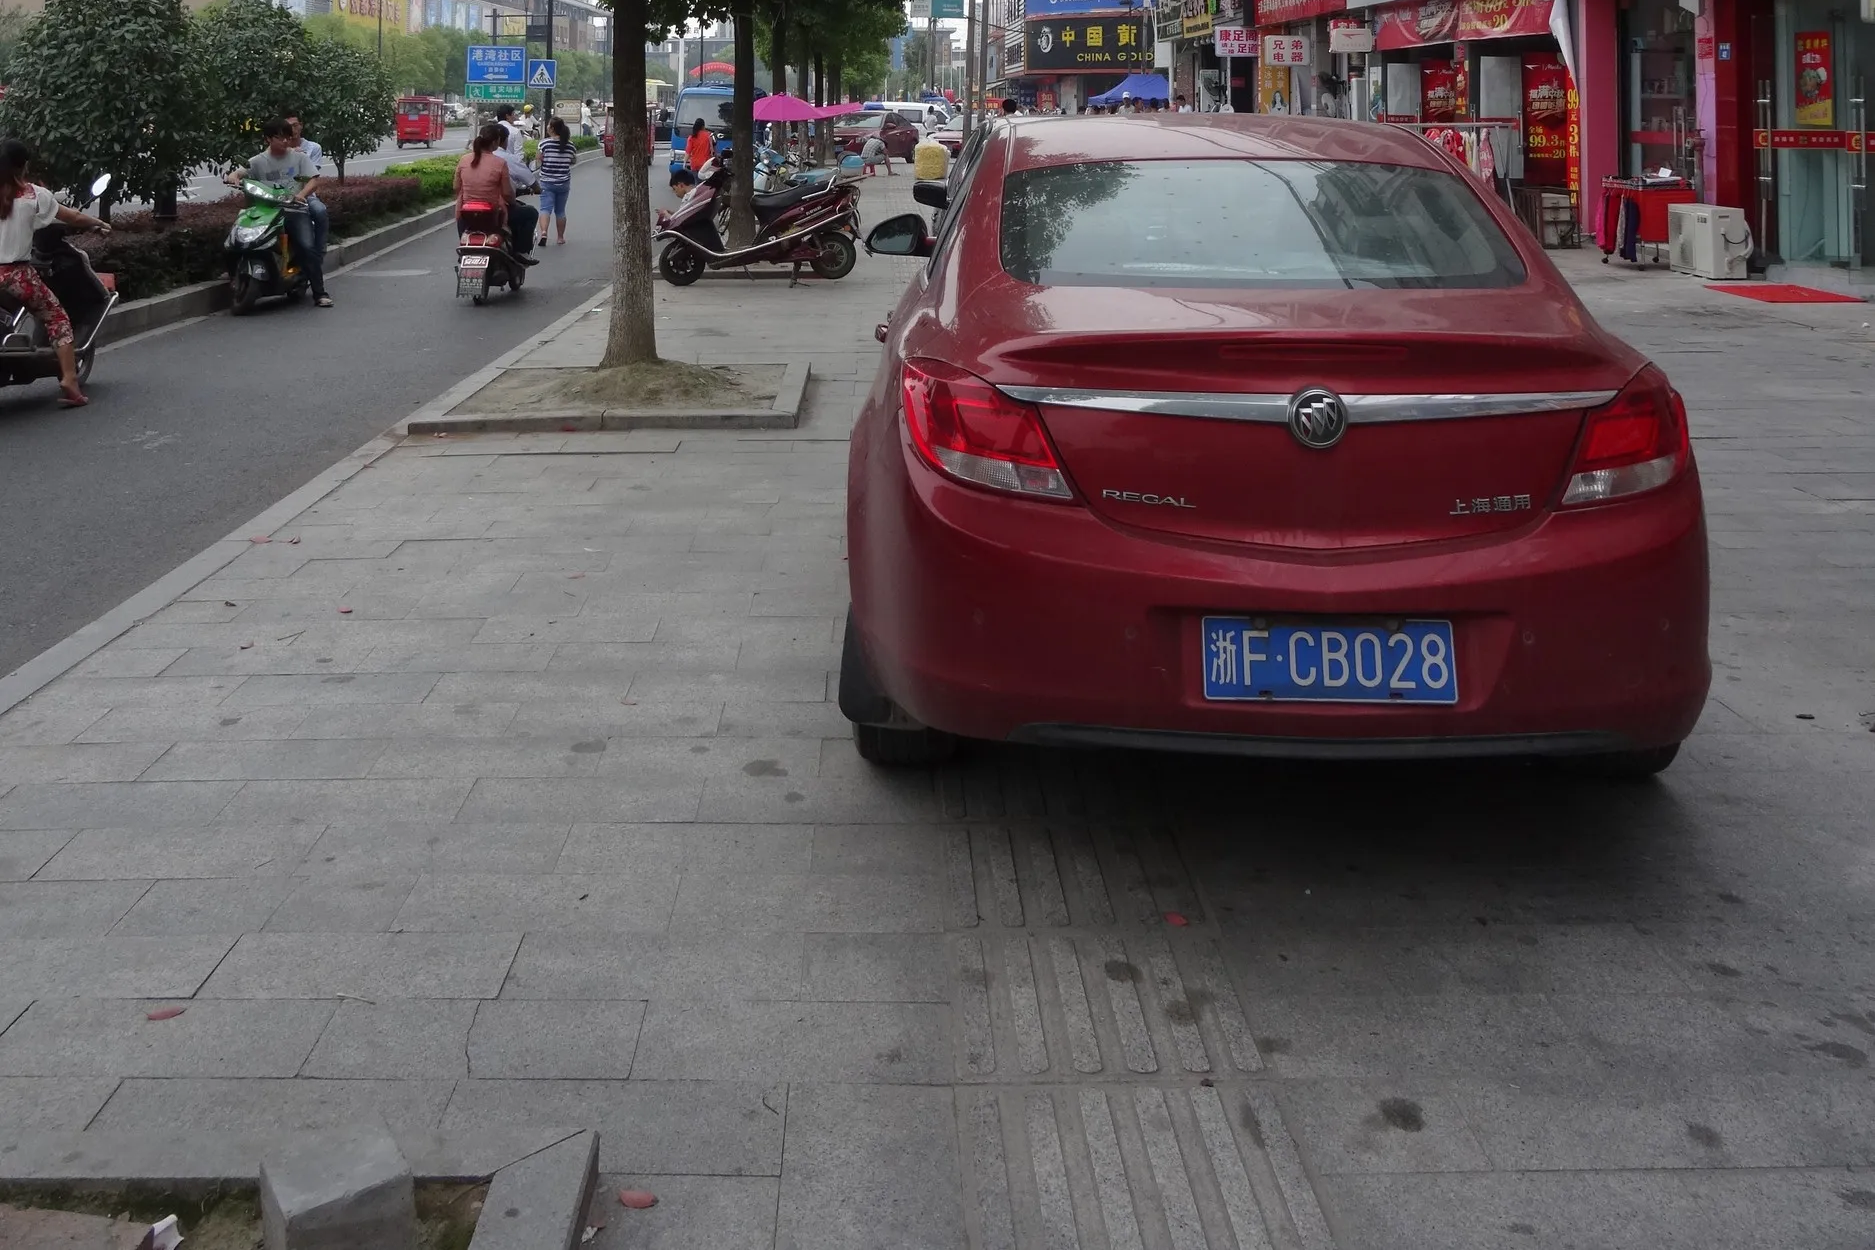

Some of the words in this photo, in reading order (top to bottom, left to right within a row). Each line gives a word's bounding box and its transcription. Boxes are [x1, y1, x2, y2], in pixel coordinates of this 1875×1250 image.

[1272, 40, 1303, 50] 兄弟
[472, 49, 522, 61] 港湾社区
[1077, 52, 1111, 62] CHINA
[1272, 52, 1304, 62] 电器
[1102, 489, 1197, 508] REGAL
[1450, 494, 1531, 516] 上海通用
